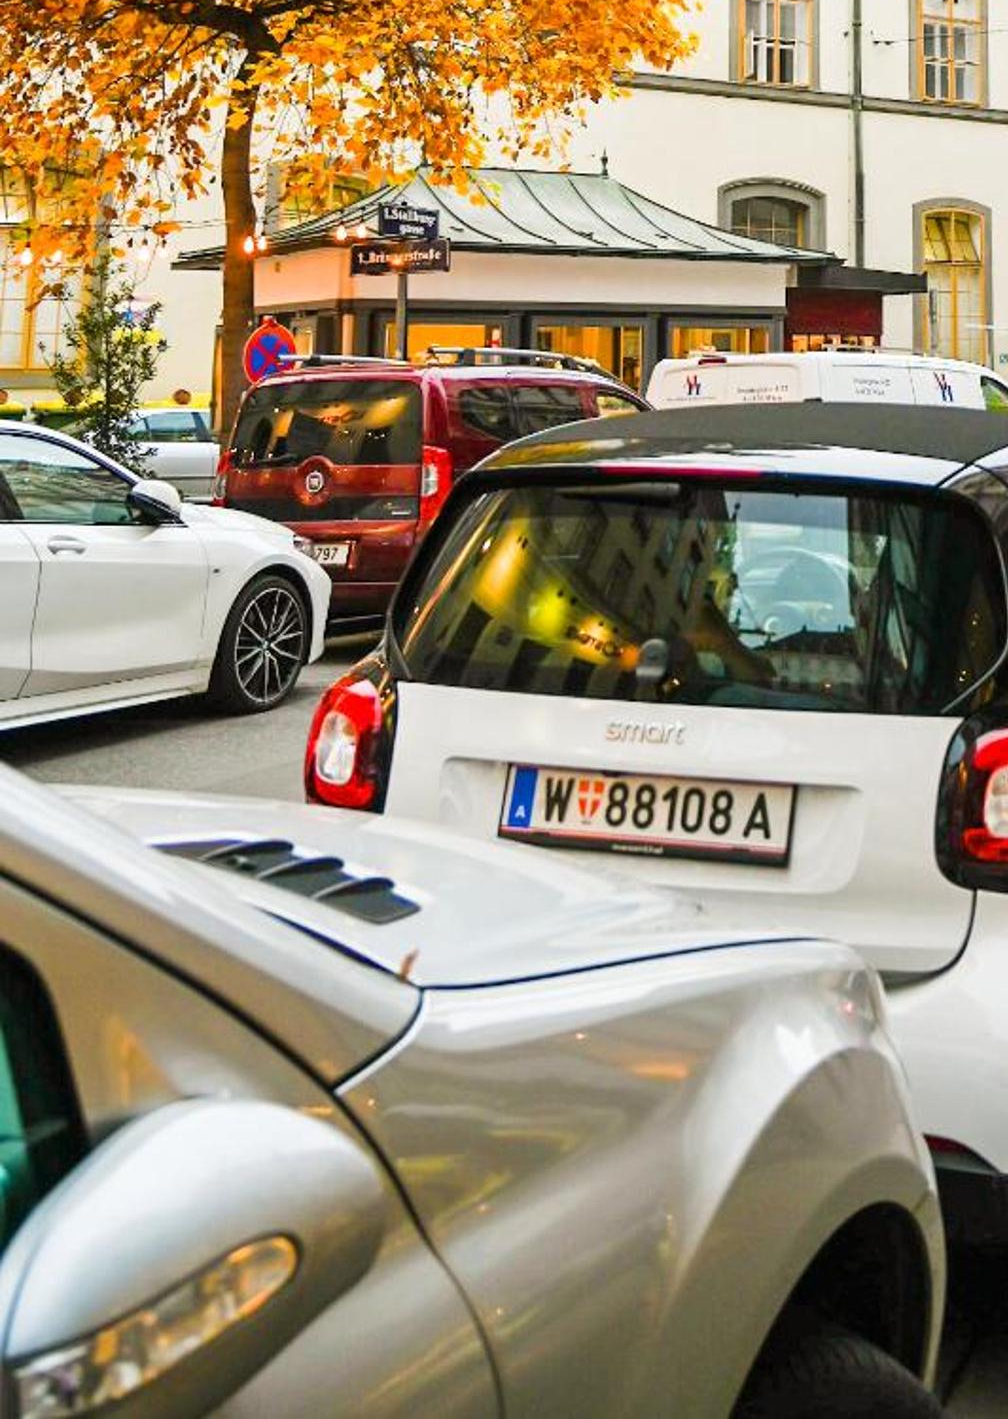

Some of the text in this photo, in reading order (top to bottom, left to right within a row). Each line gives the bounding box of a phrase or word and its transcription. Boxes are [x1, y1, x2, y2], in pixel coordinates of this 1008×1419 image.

[605, 722, 687, 745] smart
[514, 805, 526, 819] A
[545, 777, 771, 840] W 88108 A
